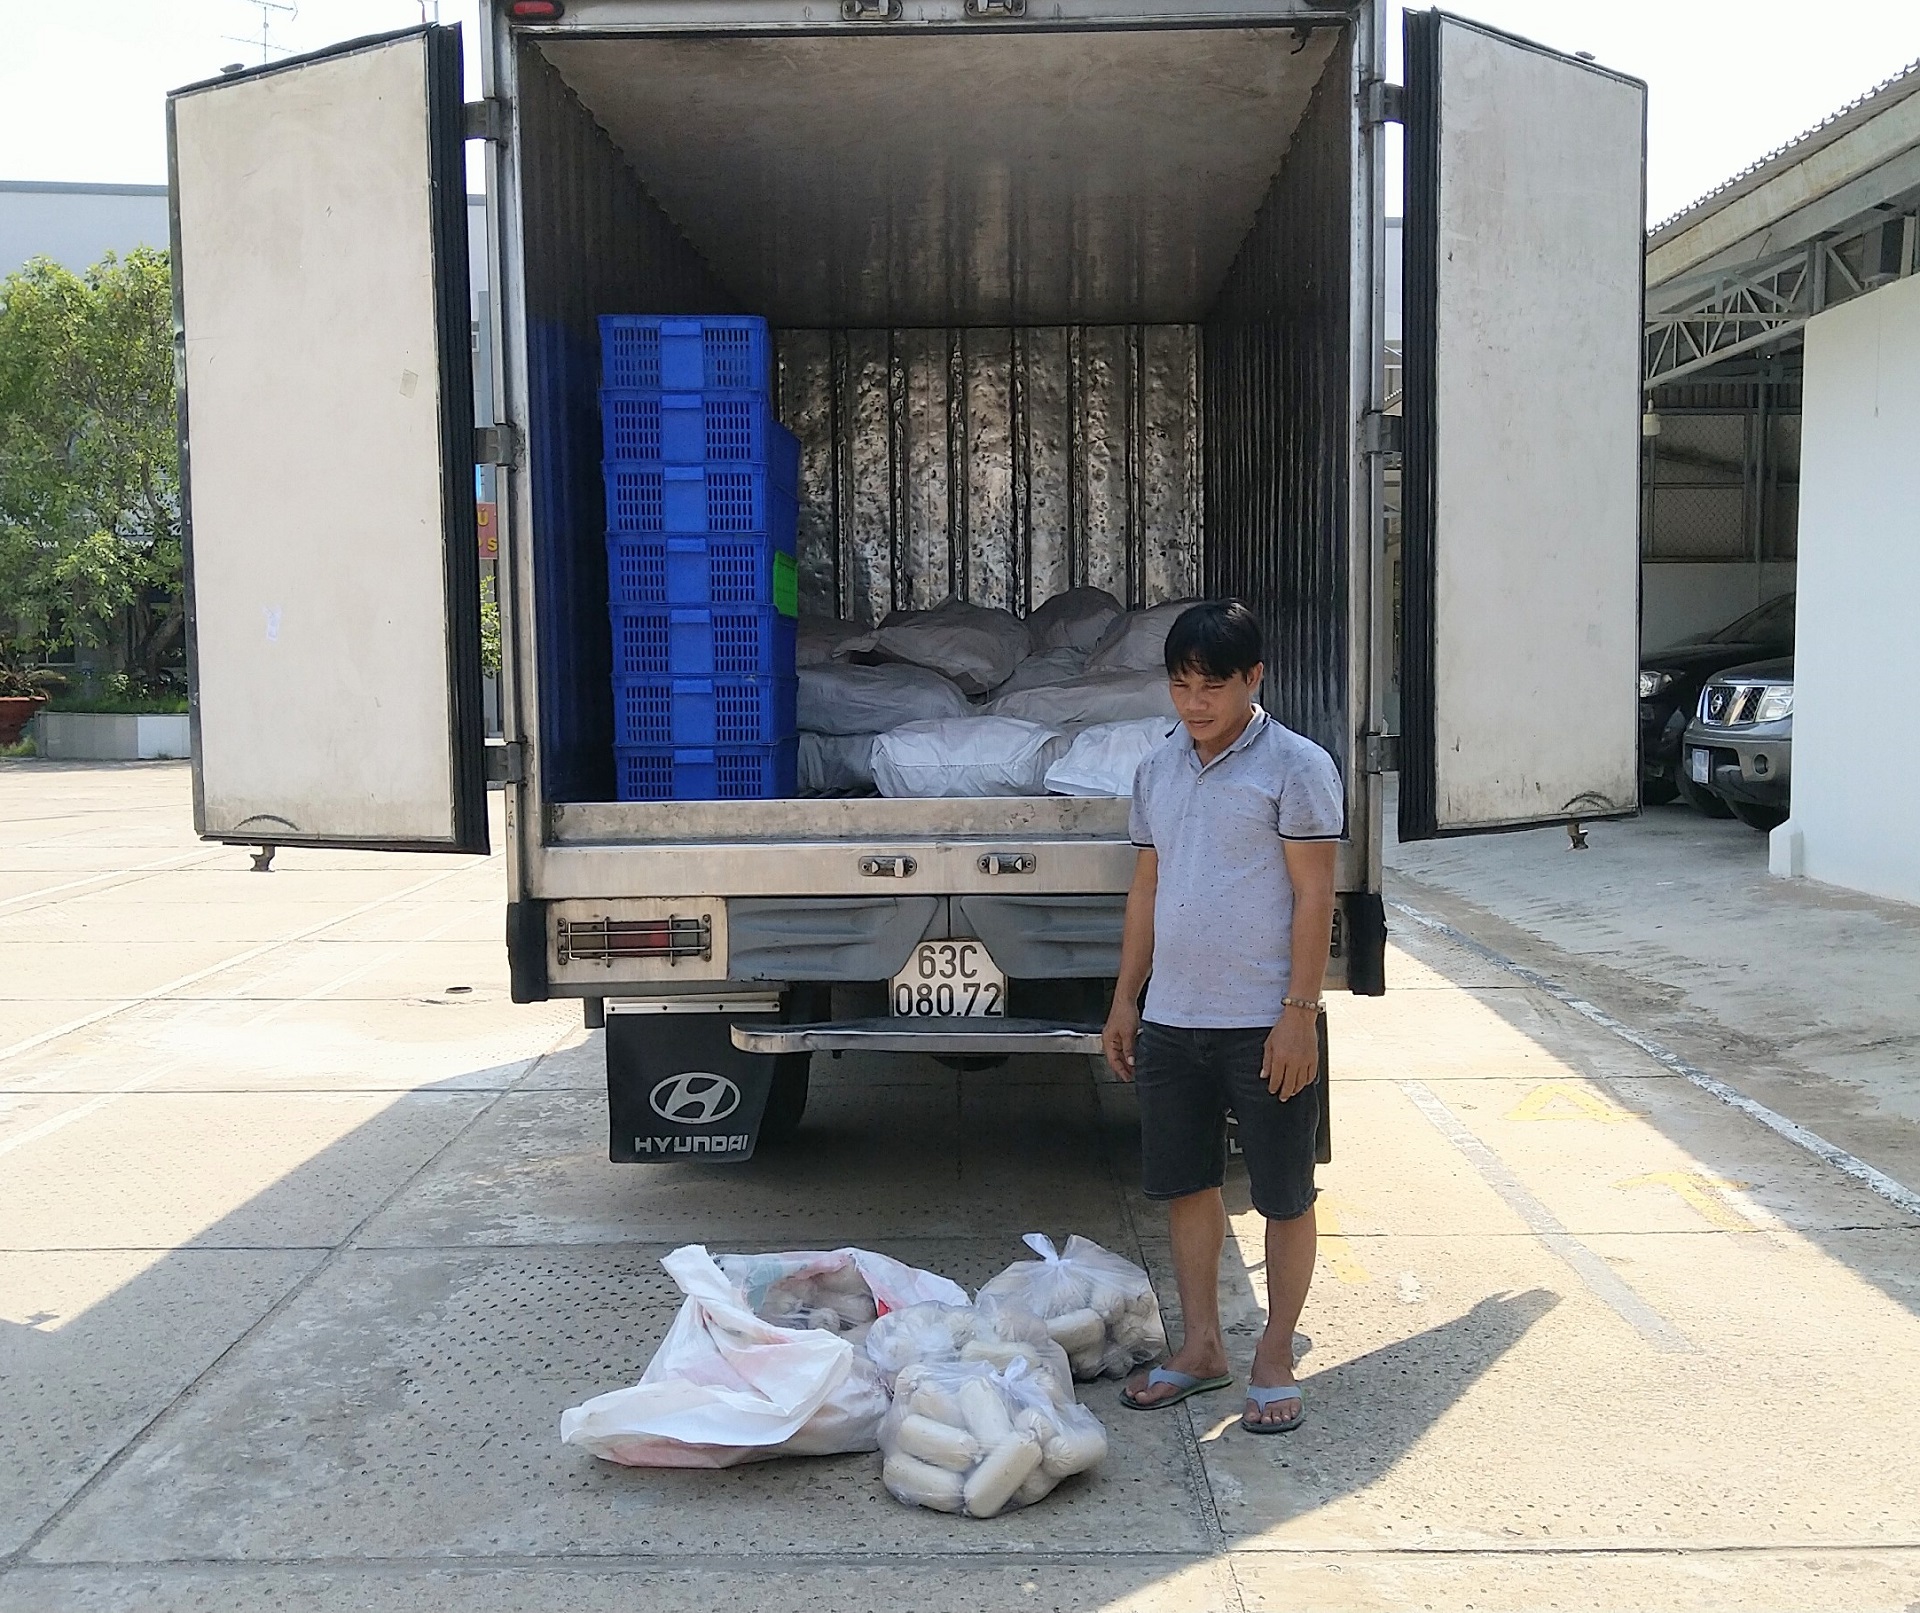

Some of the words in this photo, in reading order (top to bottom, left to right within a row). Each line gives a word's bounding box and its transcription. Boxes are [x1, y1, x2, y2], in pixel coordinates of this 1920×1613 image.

[918, 944, 978, 979] 63C
[895, 983, 1002, 1017] 080.72
[634, 1134, 749, 1153] HYUNDAI
